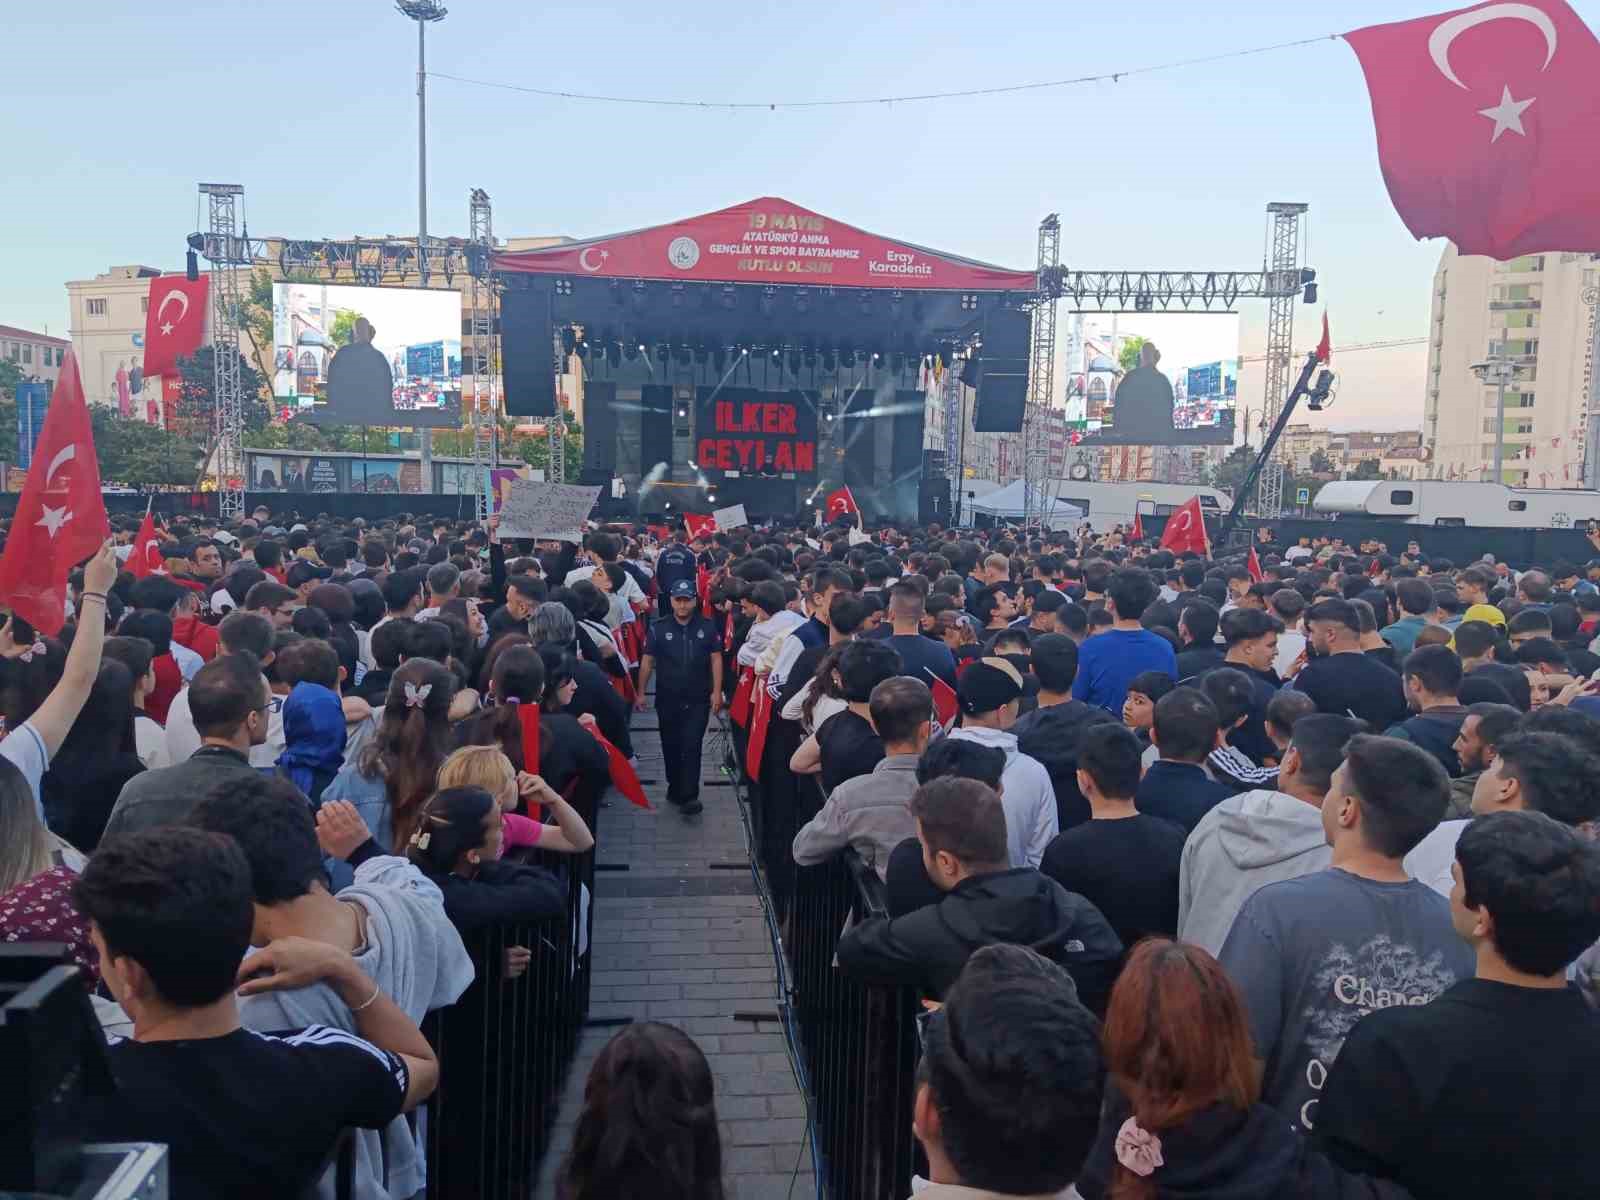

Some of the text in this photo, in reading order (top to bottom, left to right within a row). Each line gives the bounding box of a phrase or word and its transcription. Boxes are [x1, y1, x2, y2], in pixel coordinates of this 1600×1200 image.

[748, 213, 824, 231] 19 MAYIS
[743, 231, 830, 245] ATATÜRK'Ü ANMA
[709, 243, 860, 259] GENÇLİK VE SPOR BAYRAMIMIZ
[887, 250, 914, 264] Eray
[737, 259, 833, 273] KUTLU OLSUN
[869, 260, 933, 274] Karadeniz
[698, 438, 815, 471] CEYLAN
